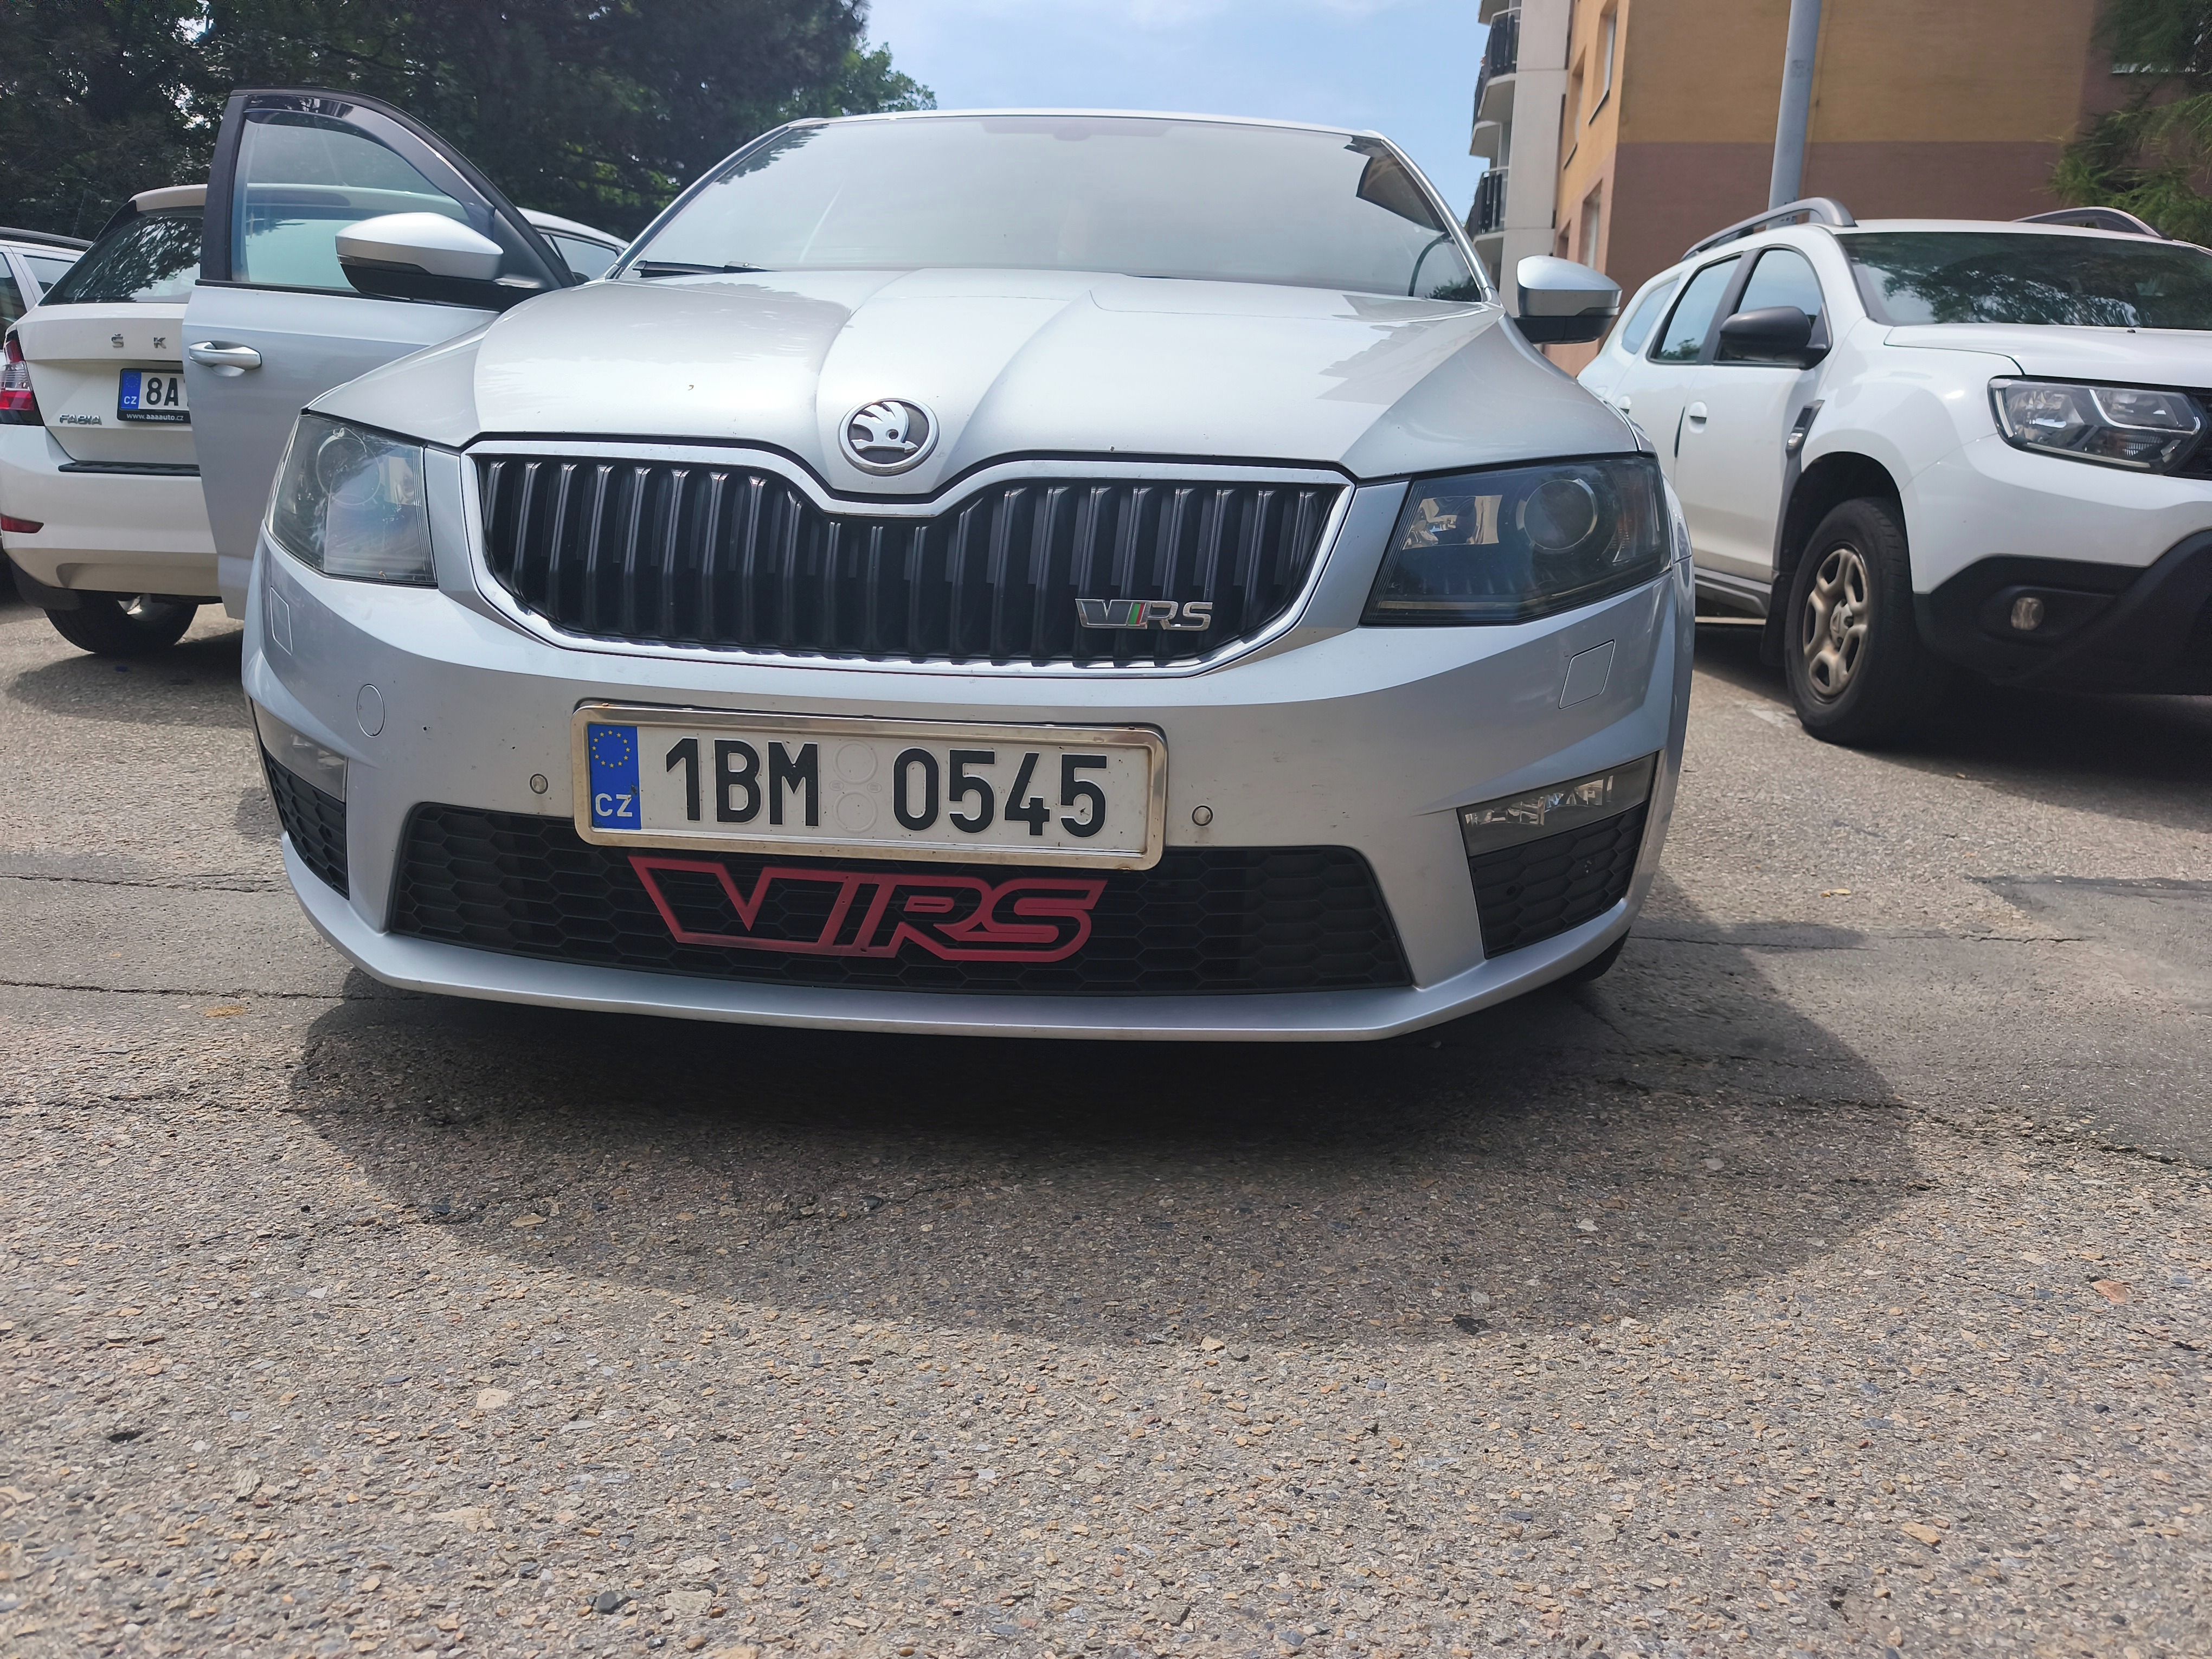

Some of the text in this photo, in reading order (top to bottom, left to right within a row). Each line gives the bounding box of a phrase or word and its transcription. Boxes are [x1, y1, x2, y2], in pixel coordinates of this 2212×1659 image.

[124, 396, 137, 405] CZ
[146, 377, 188, 407] 8A
[59, 414, 102, 426] FABIA
[126, 413, 184, 421] www.aaaauto.cz
[665, 737, 1108, 838] 1BM 0545
[595, 793, 633, 817] CZ
